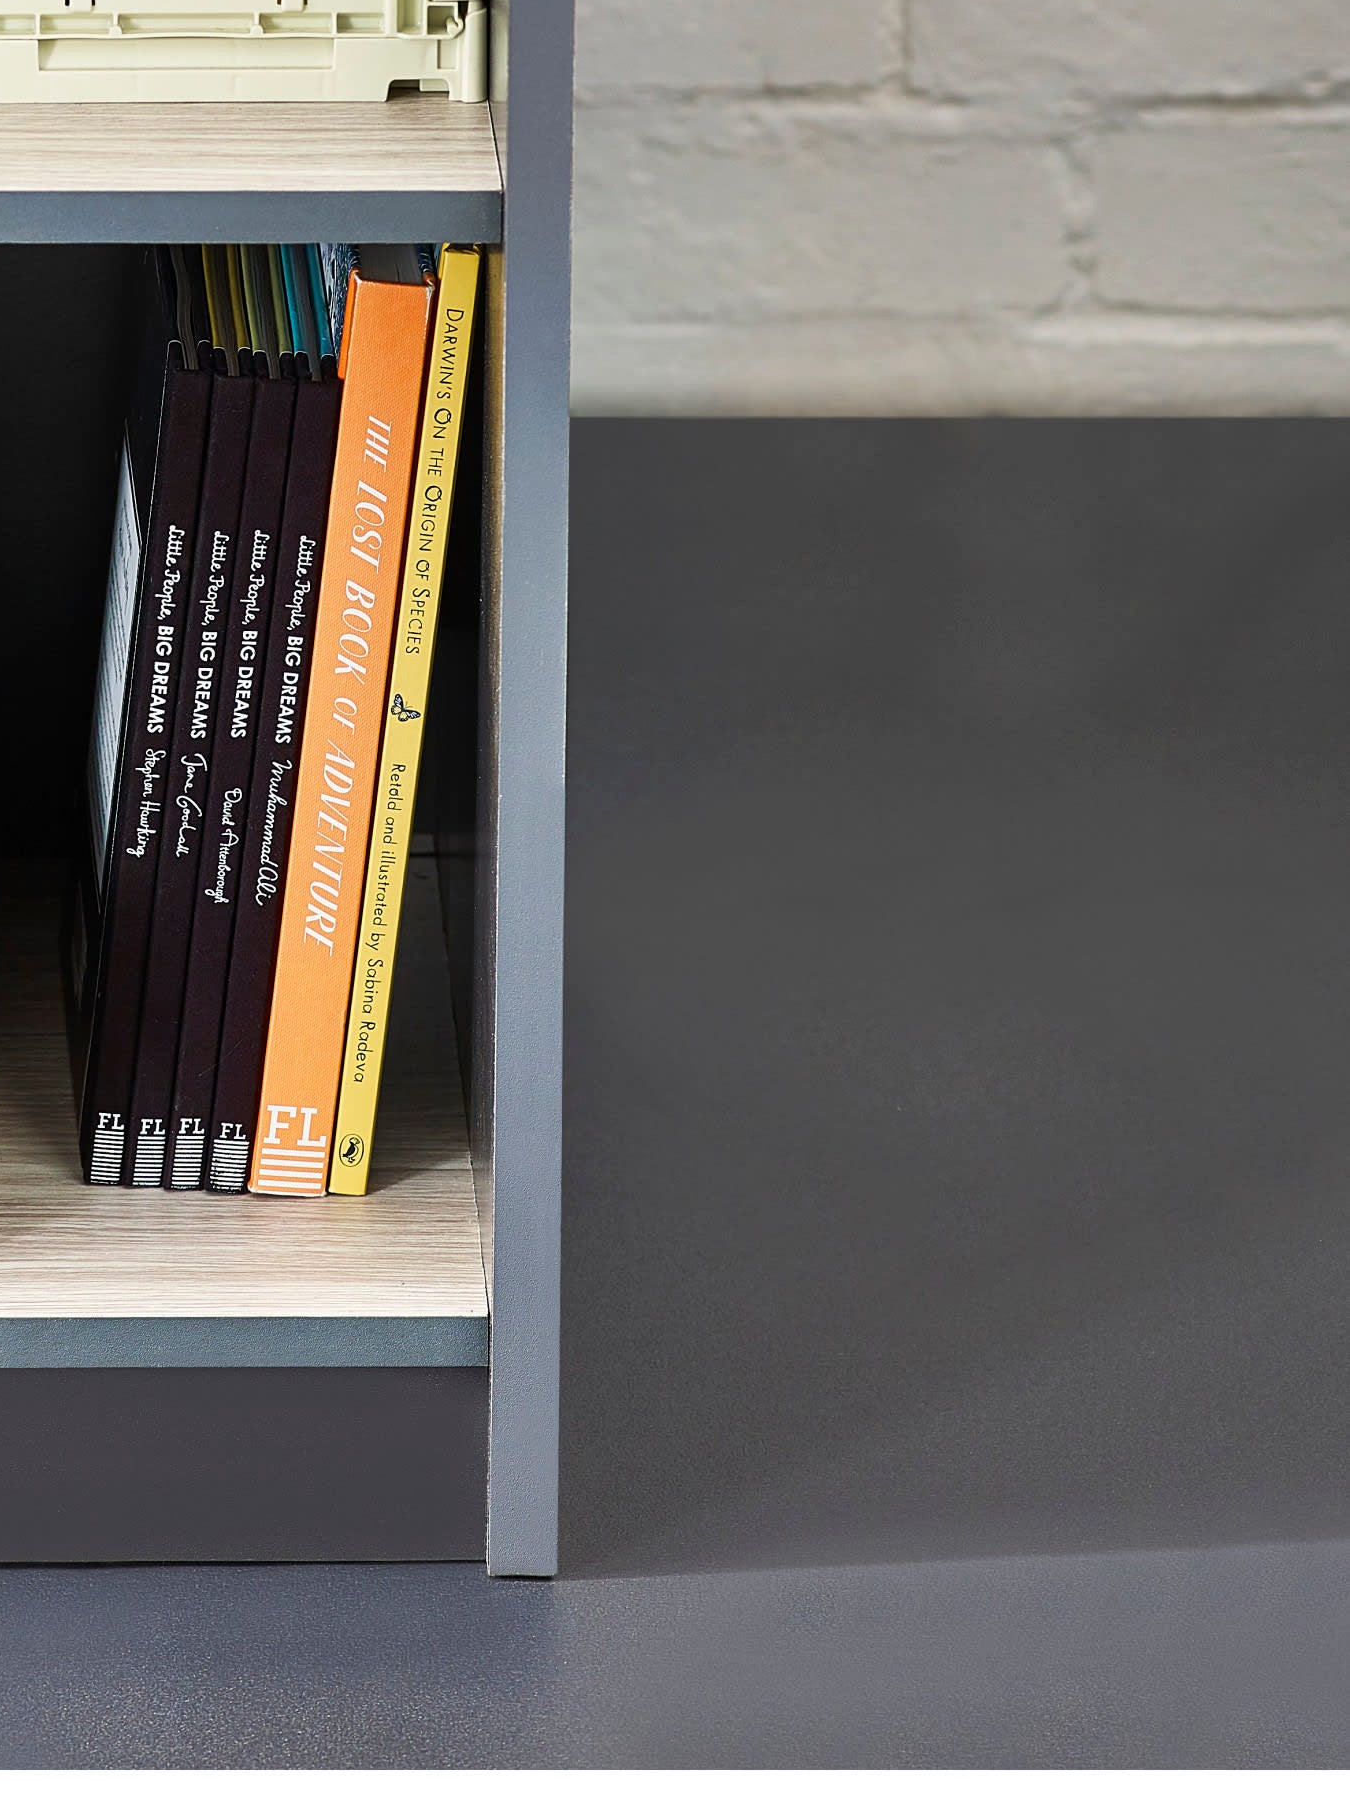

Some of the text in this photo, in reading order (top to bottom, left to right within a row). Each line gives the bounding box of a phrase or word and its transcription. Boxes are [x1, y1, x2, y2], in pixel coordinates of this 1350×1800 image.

[405, 308, 464, 654] DARWIN'S ON THE ORIGIN OF SPECIES
[147, 525, 185, 734] Little People, BIG DREAMS
[191, 531, 230, 739] Little People, BIG DREAMS
[230, 529, 270, 738] Little People, BIG DREAMS
[275, 535, 316, 744] Little People, BIG DREAMS
[303, 415, 392, 957] THE LOST BOOK OF ADVENTURE
[126, 748, 166, 858] Stephen Hawking
[176, 753, 207, 857] Jane Goodall
[205, 788, 242, 904] David Attenborough
[255, 760, 293, 906] Muhammad Ali
[353, 763, 406, 1084] Retold and illustrated by Sabina Radeva
[97, 1112, 125, 1130] FL
[140, 1118, 166, 1135] FL
[179, 1118, 205, 1135] FL
[220, 1123, 247, 1140] FL
[263, 1104, 327, 1147] FL
